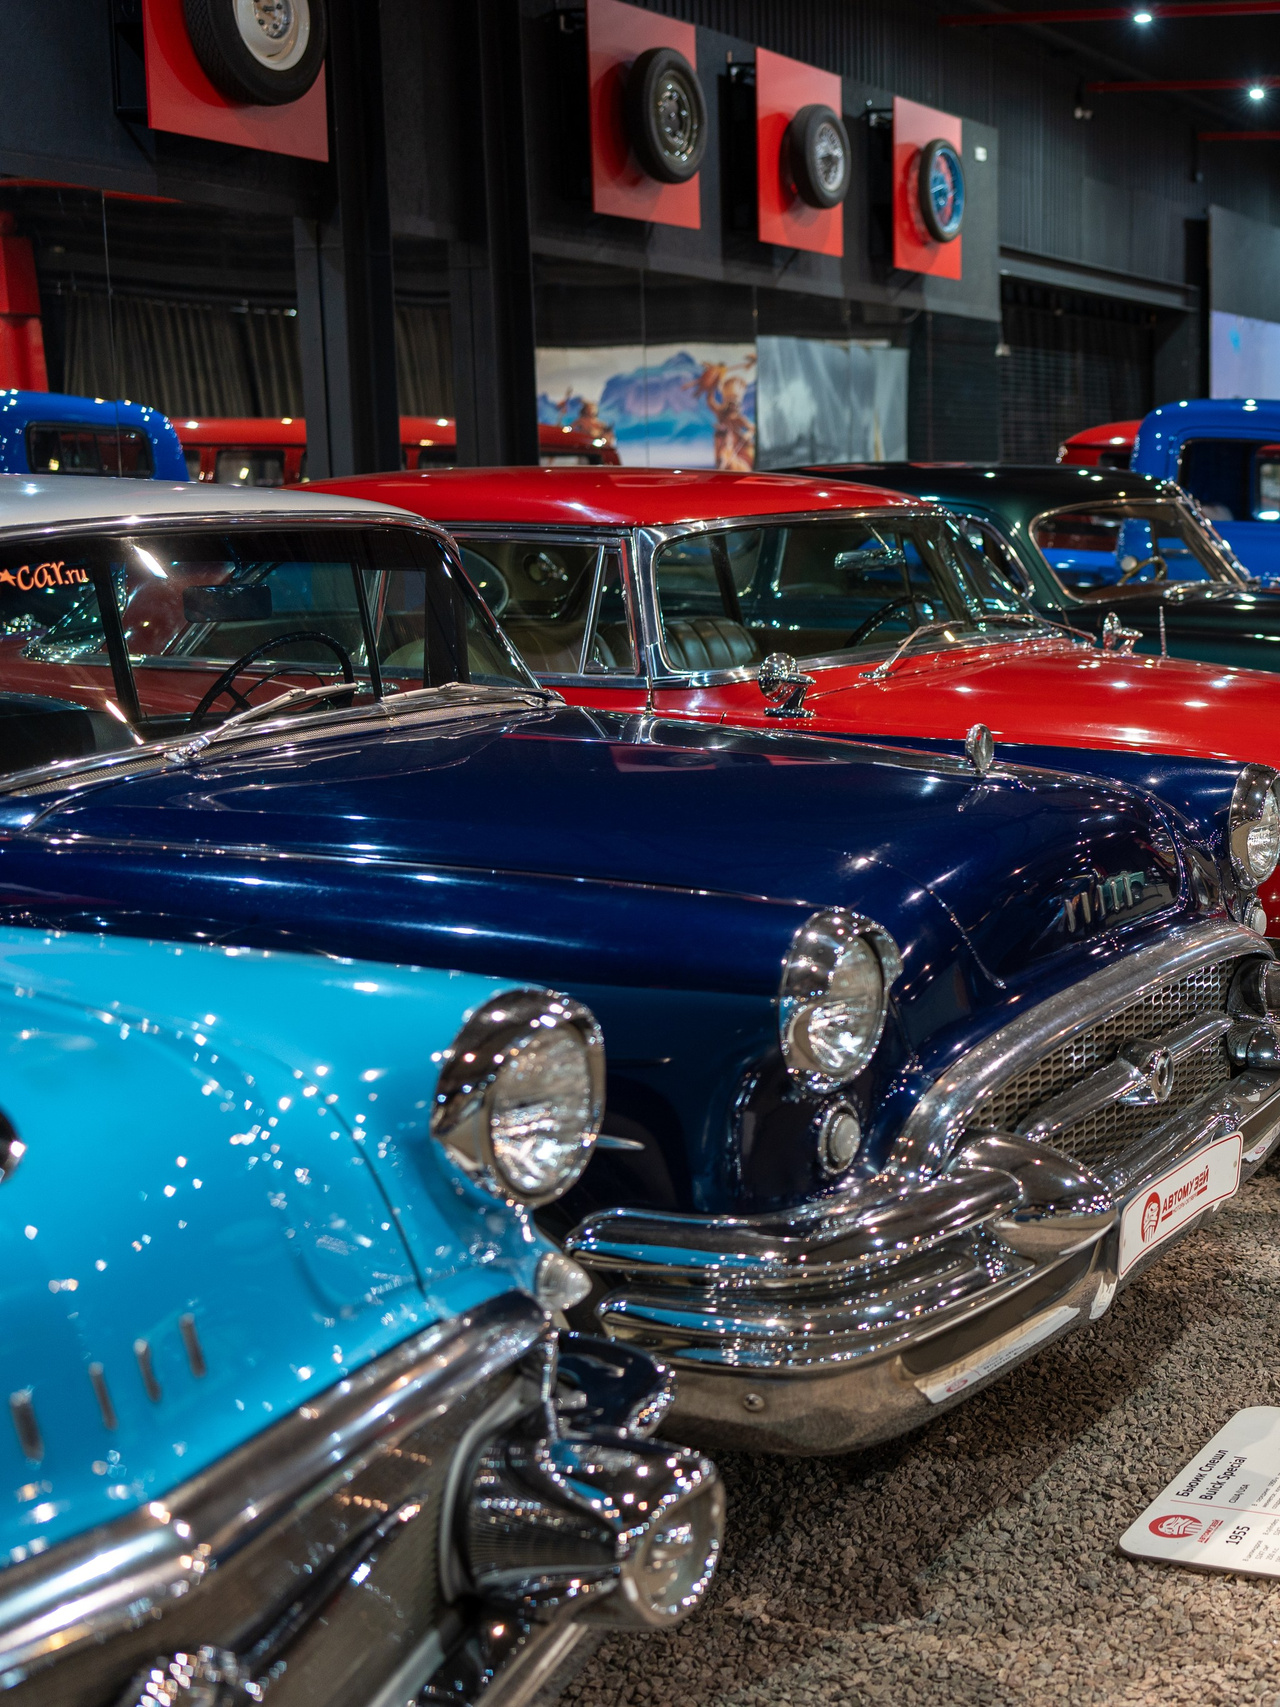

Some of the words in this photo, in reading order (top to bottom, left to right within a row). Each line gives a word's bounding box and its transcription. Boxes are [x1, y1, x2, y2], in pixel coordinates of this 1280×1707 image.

[1162, 1165, 1209, 1214] АВТОМУЗЕЙ
[1175, 1473, 1208, 1497] Бьюик
[1199, 1449, 1229, 1472] Спешл
[1198, 1481, 1226, 1500] Buick
[1217, 1456, 1247, 1480] Special
[1225, 1525, 1250, 1545] 1955
